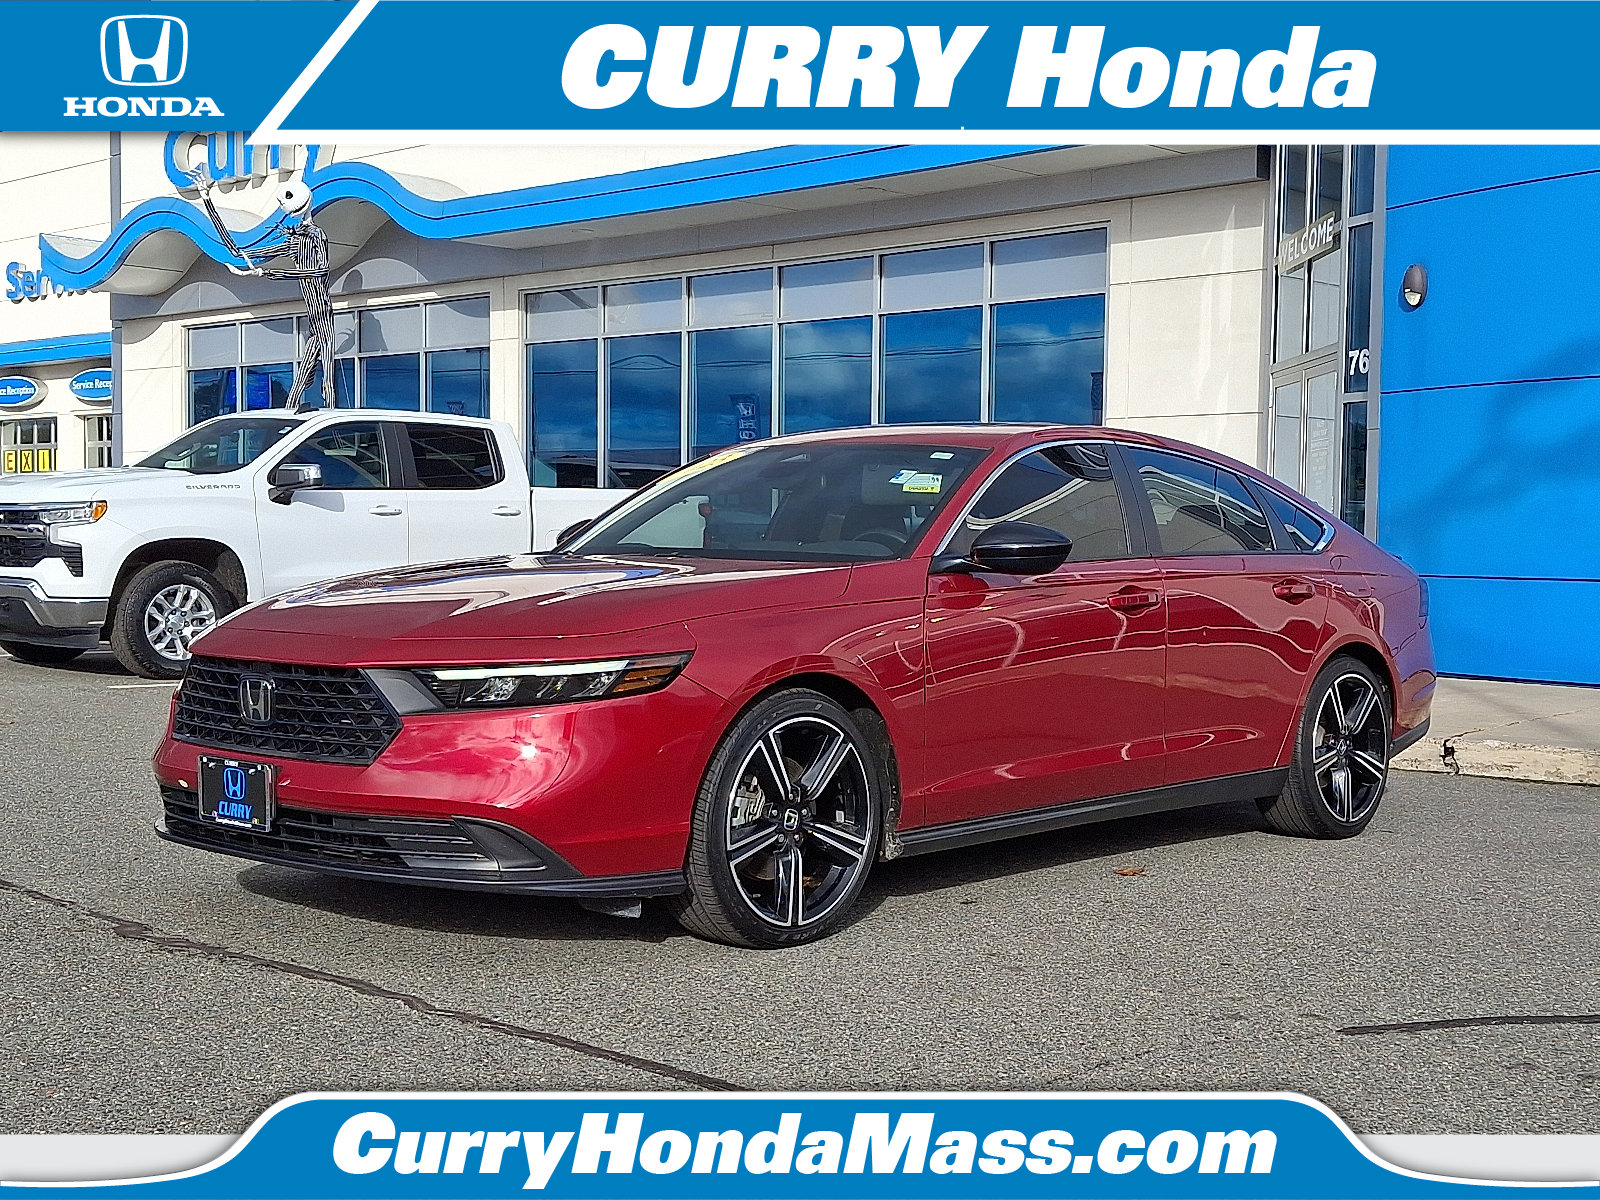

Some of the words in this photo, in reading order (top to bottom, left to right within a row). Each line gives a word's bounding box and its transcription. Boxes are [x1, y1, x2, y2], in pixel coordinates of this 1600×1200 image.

[1279, 216, 1335, 265] WELCOME
[1348, 348, 1370, 376] 76
[72, 379, 95, 390] Service
[94, 378, 112, 391] Recep
[6, 451, 46, 471] EXI
[218, 800, 253, 820] CURRY
